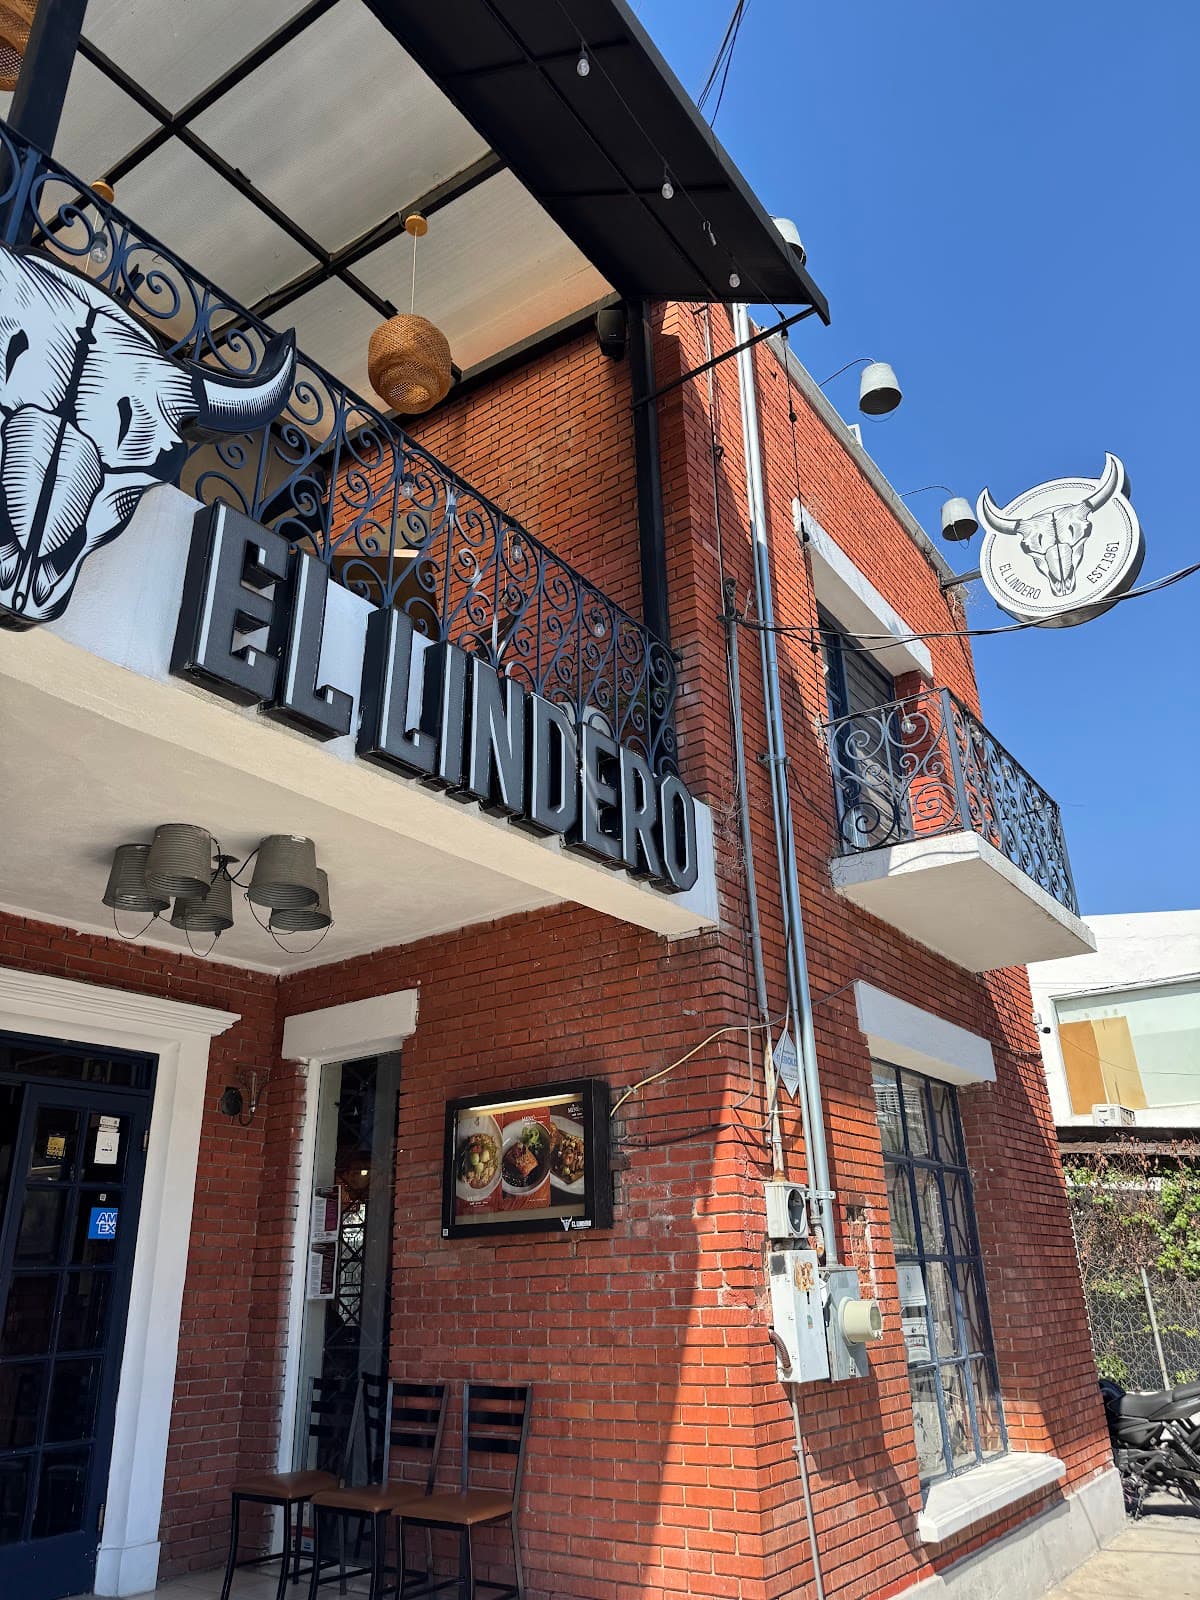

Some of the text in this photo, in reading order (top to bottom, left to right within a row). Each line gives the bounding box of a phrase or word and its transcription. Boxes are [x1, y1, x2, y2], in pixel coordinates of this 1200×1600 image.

[999, 563, 1042, 600] EL LINDERO
[1086, 563, 1110, 584] EST.
[174, 497, 700, 895] EL LINDERO
